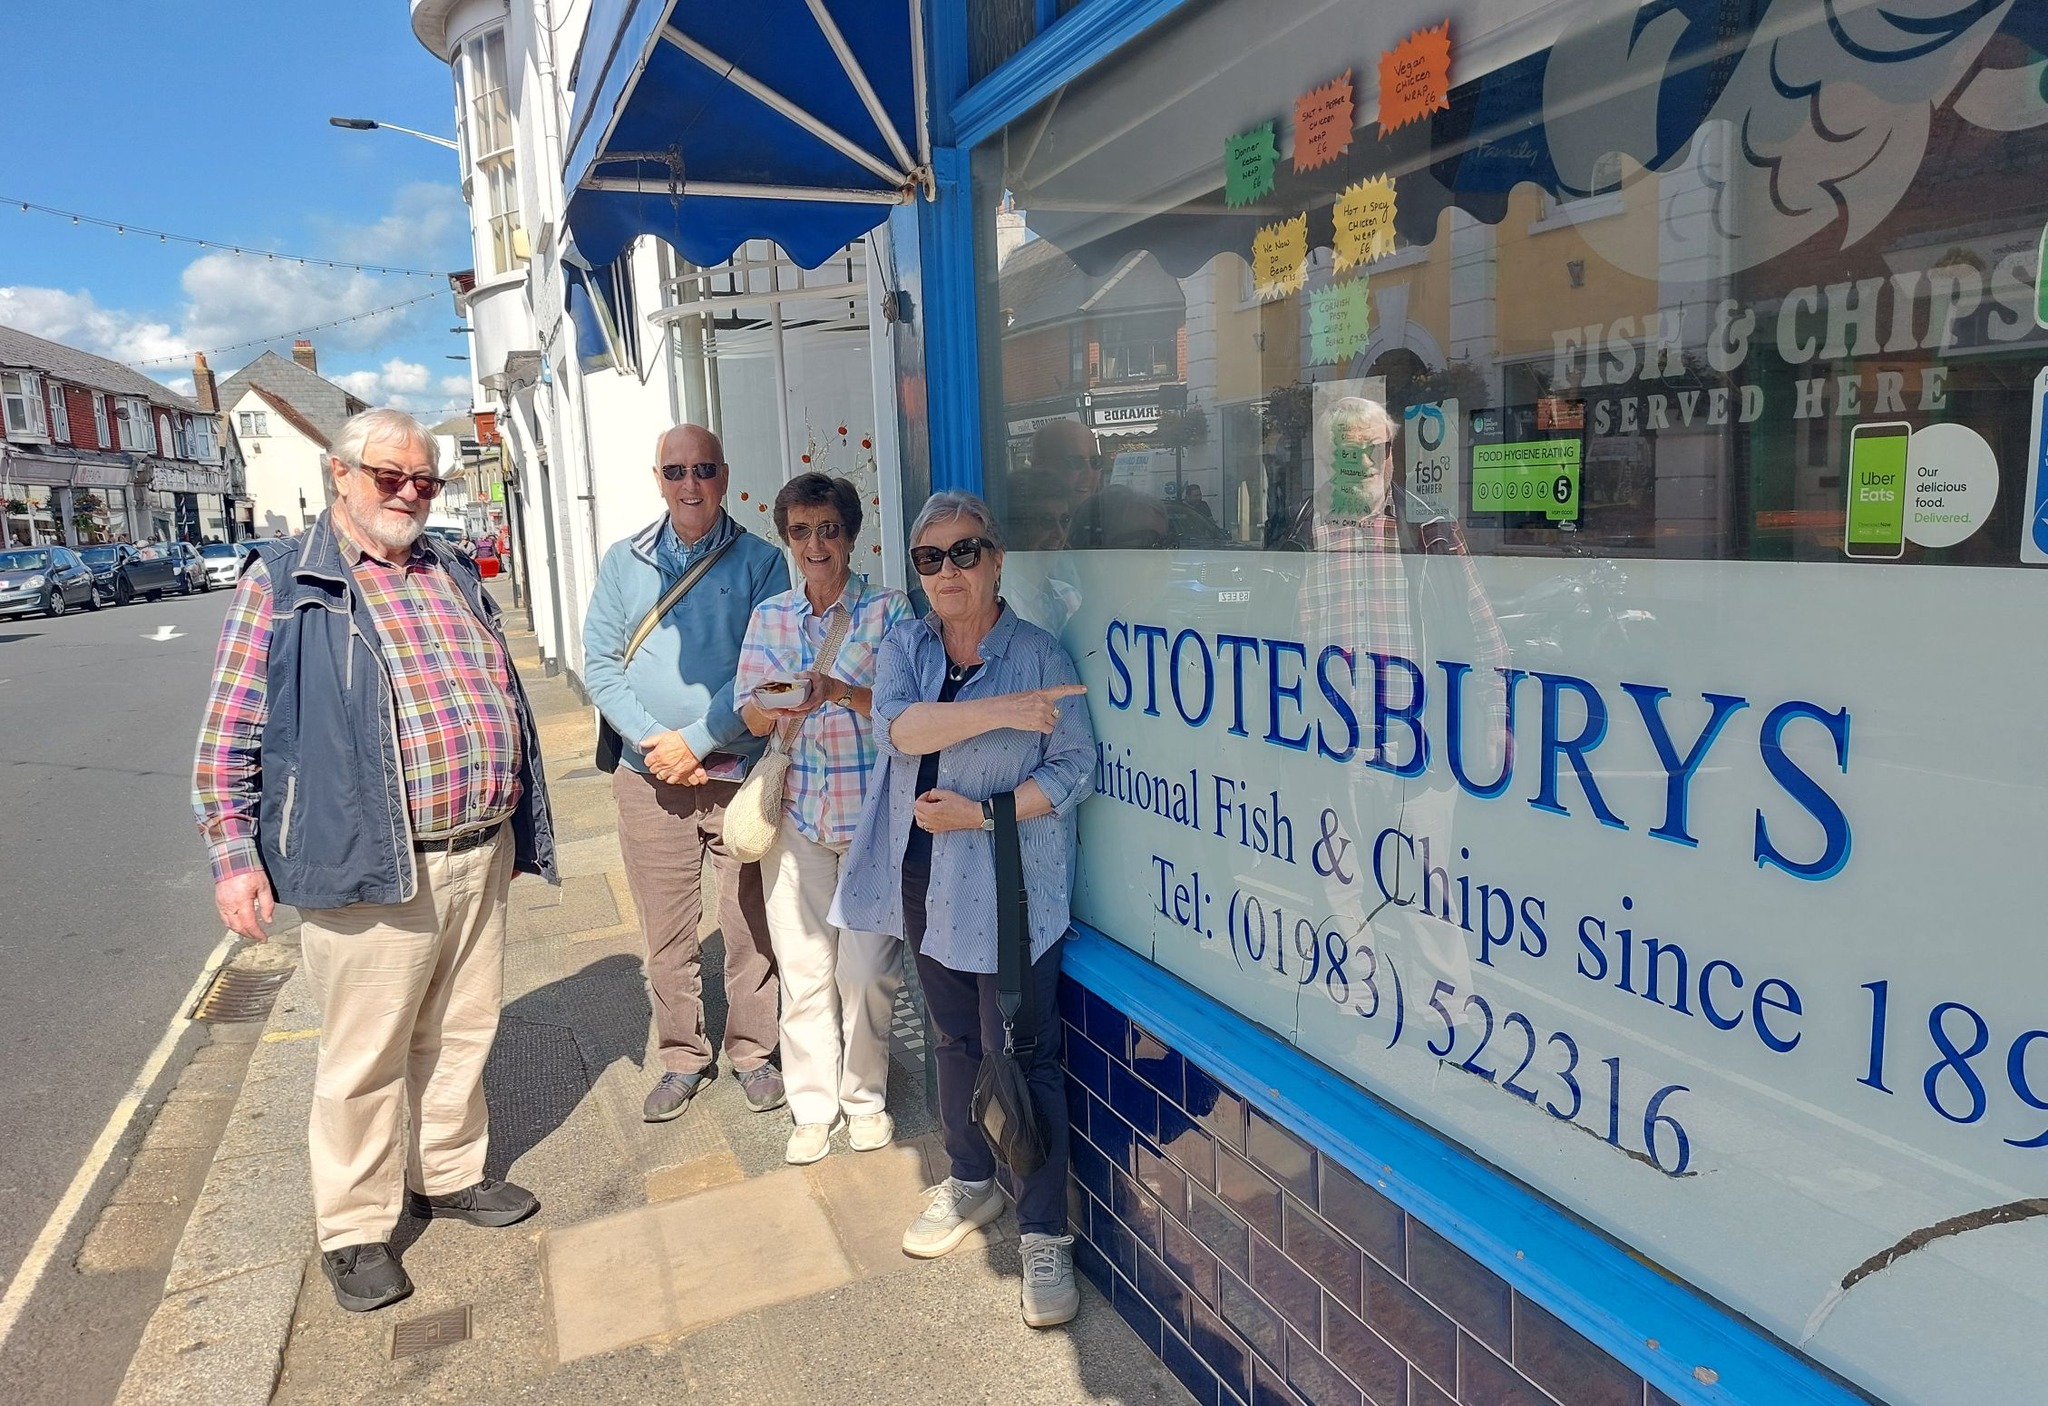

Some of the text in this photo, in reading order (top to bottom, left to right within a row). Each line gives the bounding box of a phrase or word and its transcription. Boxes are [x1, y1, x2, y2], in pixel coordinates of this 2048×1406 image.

[1393, 55, 1426, 79] Vegan
[1404, 84, 1428, 102] WRAP
[1425, 90, 1436, 106] £6
[1353, 229, 1376, 242] WRAP
[1360, 242, 1371, 255] £6
[1270, 263, 1293, 277] Beans
[1551, 251, 2037, 393] FISH & CHIPS
[1594, 366, 1949, 435] SERVED HERE
[1478, 446, 1574, 462] FOOD HYGIENE RATING
[1415, 459, 1443, 484] fsb
[1861, 471, 1896, 486] Uber
[1917, 466, 1939, 478] Our
[1416, 483, 1443, 495] MEMBER
[1557, 479, 1568, 500] 5
[1860, 487, 1895, 502] Eats
[1916, 481, 1968, 492] delicious
[1915, 497, 1945, 508] food.
[1914, 512, 1972, 523] Delivered.
[1106, 619, 1852, 882] STOTESBURYS
[1095, 741, 1202, 831] ditional
[1211, 773, 1297, 865] Fish
[1311, 807, 1354, 886] &
[1372, 827, 1548, 967] Chips
[1576, 895, 1804, 1055] since
[1151, 855, 1692, 1177] Tel: (01983) 522316
